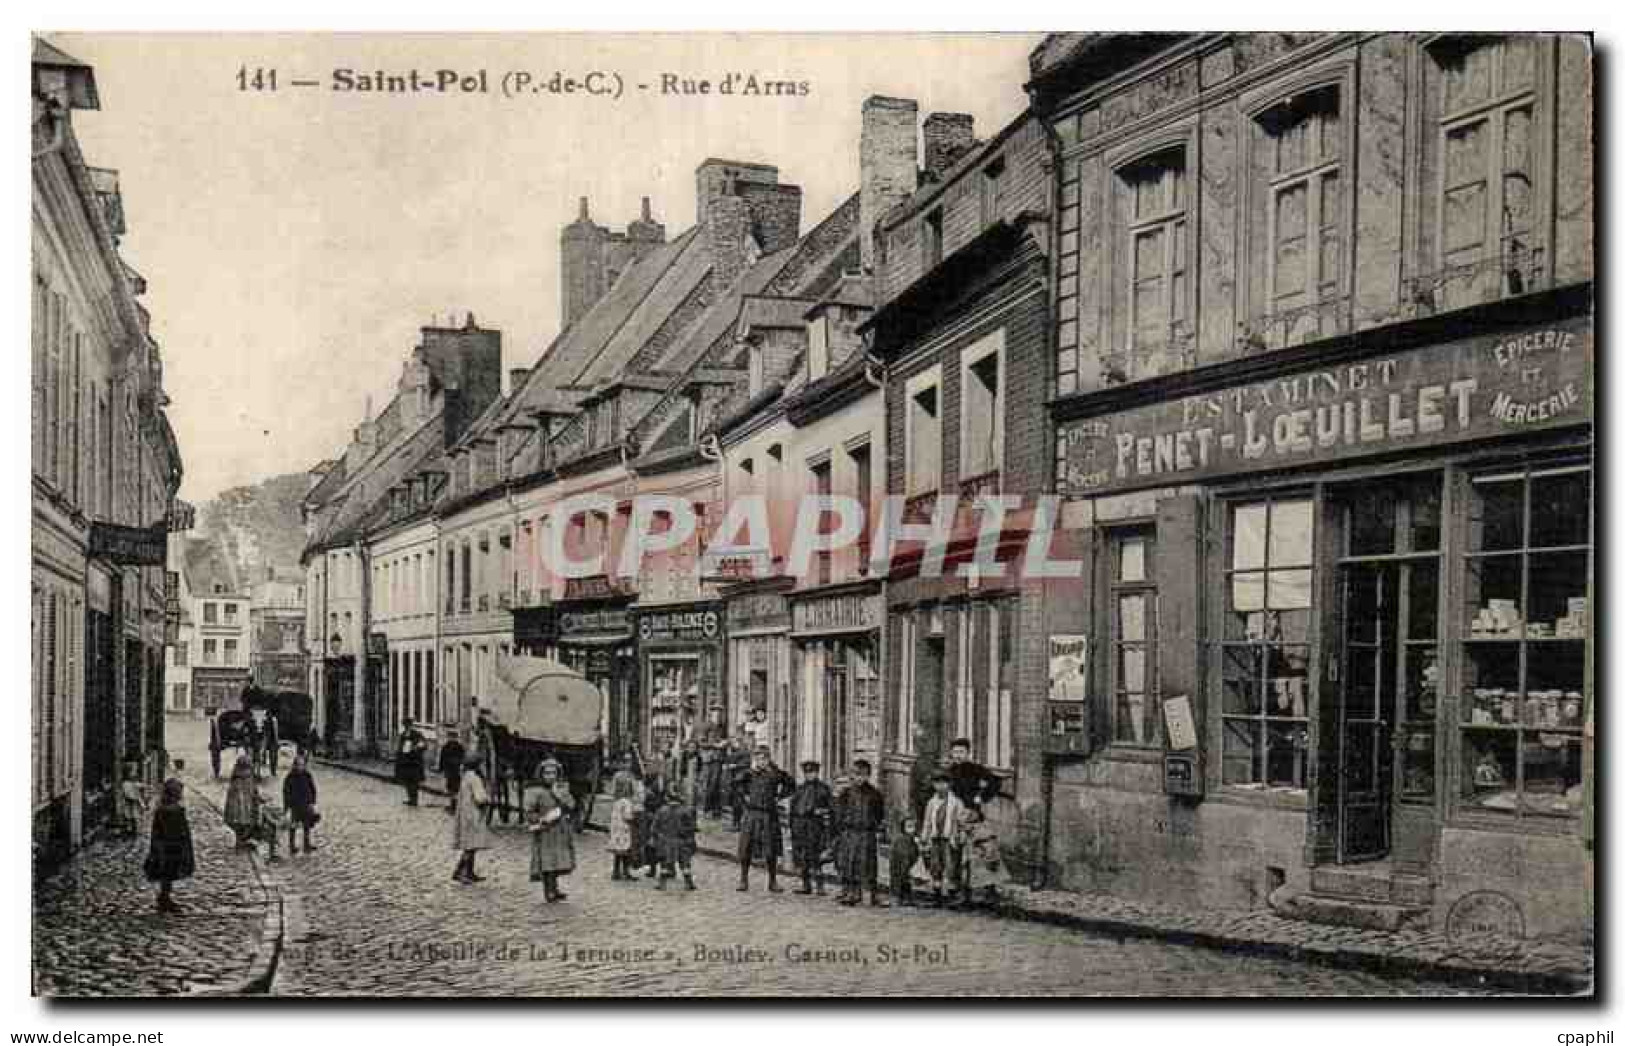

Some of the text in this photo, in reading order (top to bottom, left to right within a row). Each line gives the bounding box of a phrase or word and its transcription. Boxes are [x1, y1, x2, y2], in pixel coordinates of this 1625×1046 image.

[1494, 330, 1575, 367] EPICERIE
[1181, 359, 1398, 426] ESTAMINET
[1489, 382, 1580, 424] MERCERIE
